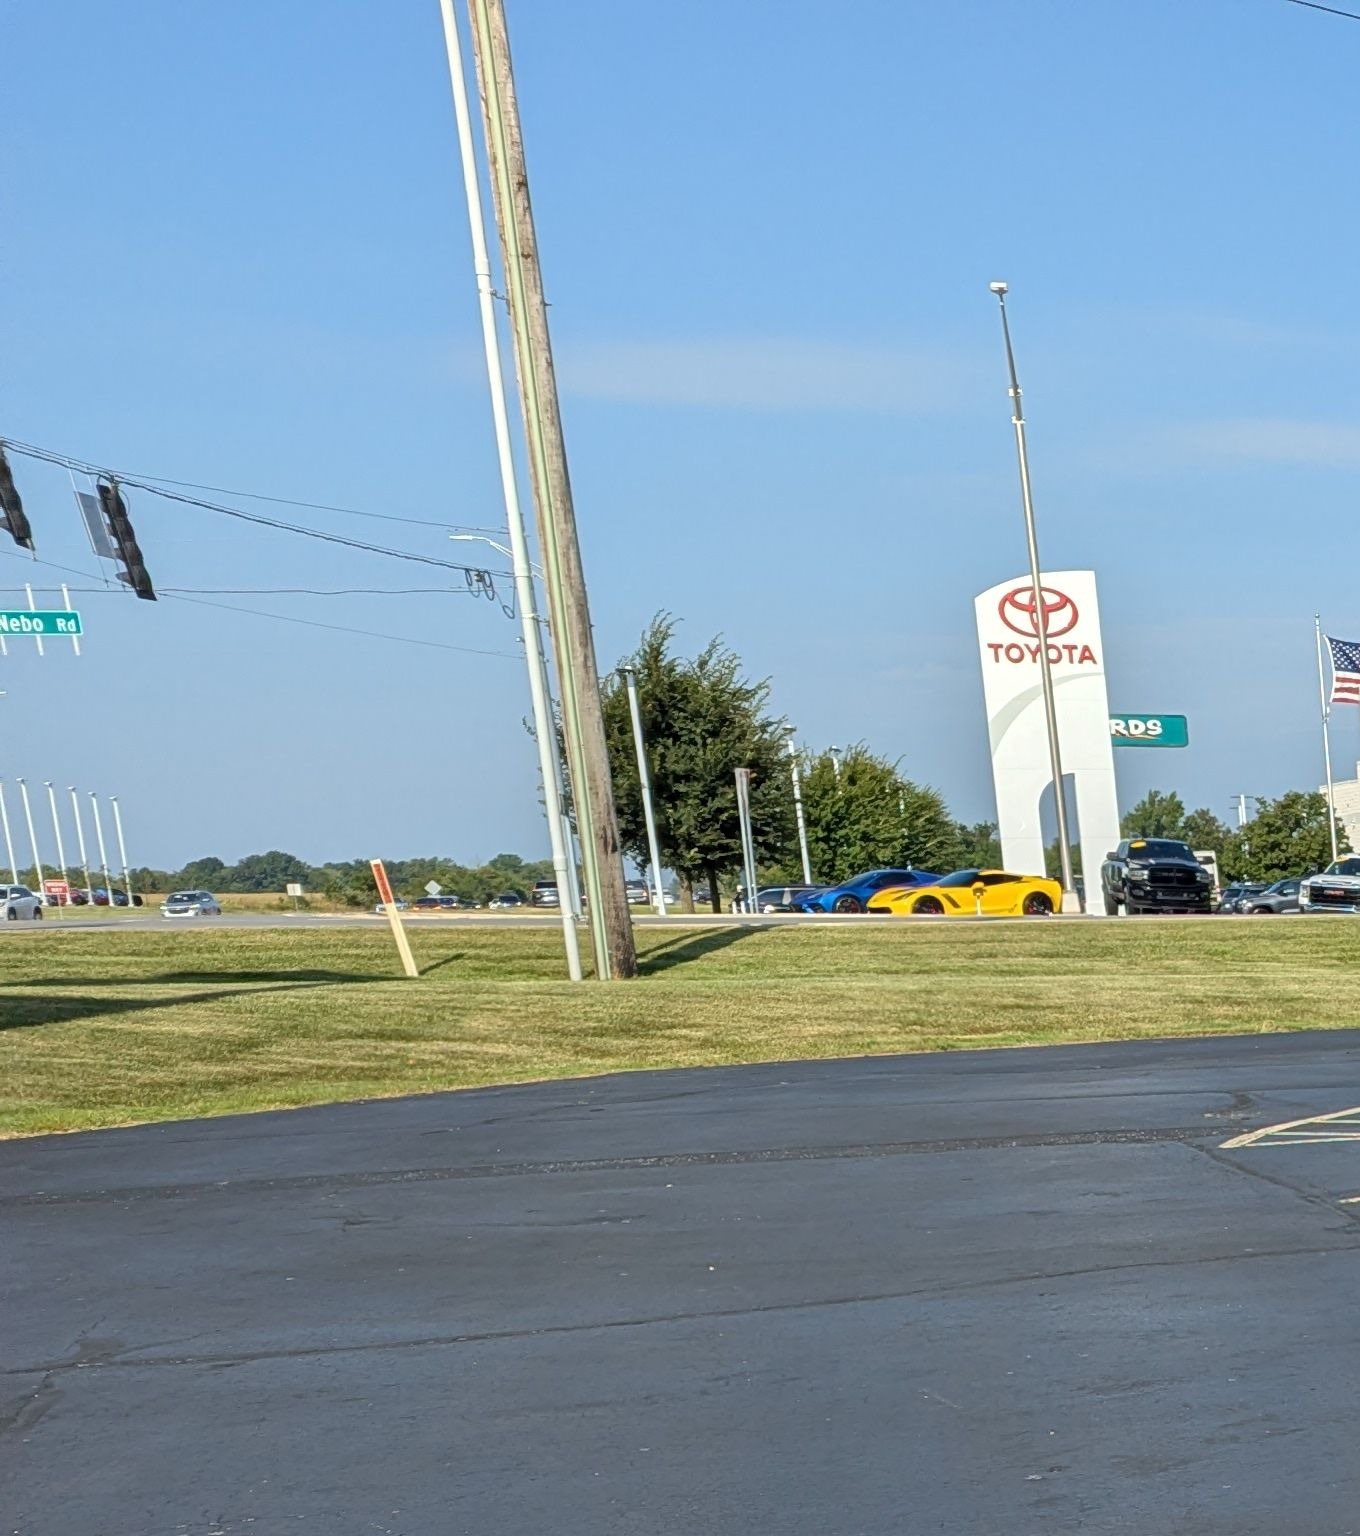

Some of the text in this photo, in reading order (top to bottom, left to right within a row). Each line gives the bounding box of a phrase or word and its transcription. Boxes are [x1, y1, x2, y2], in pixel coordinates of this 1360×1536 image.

[0, 614, 77, 632] Nebo Rd
[987, 643, 1098, 665] TOYOTA
